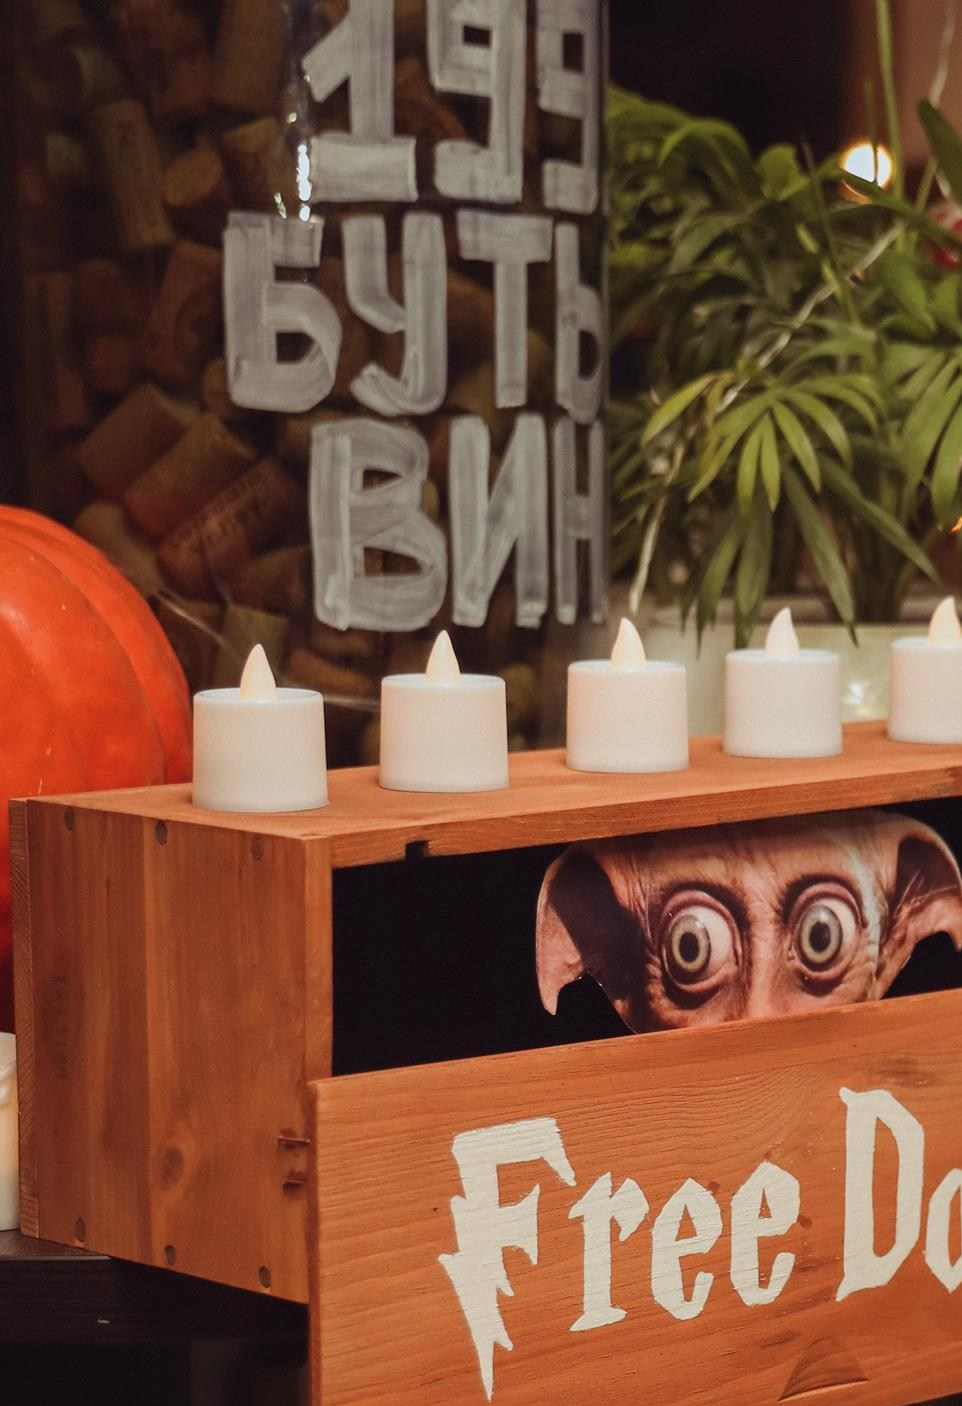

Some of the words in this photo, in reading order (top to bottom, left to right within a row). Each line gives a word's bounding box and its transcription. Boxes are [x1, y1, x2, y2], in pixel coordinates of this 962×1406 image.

[302, 0, 598, 213] 199
[309, 412, 604, 631] ВИН
[438, 1117, 801, 1402] Free
